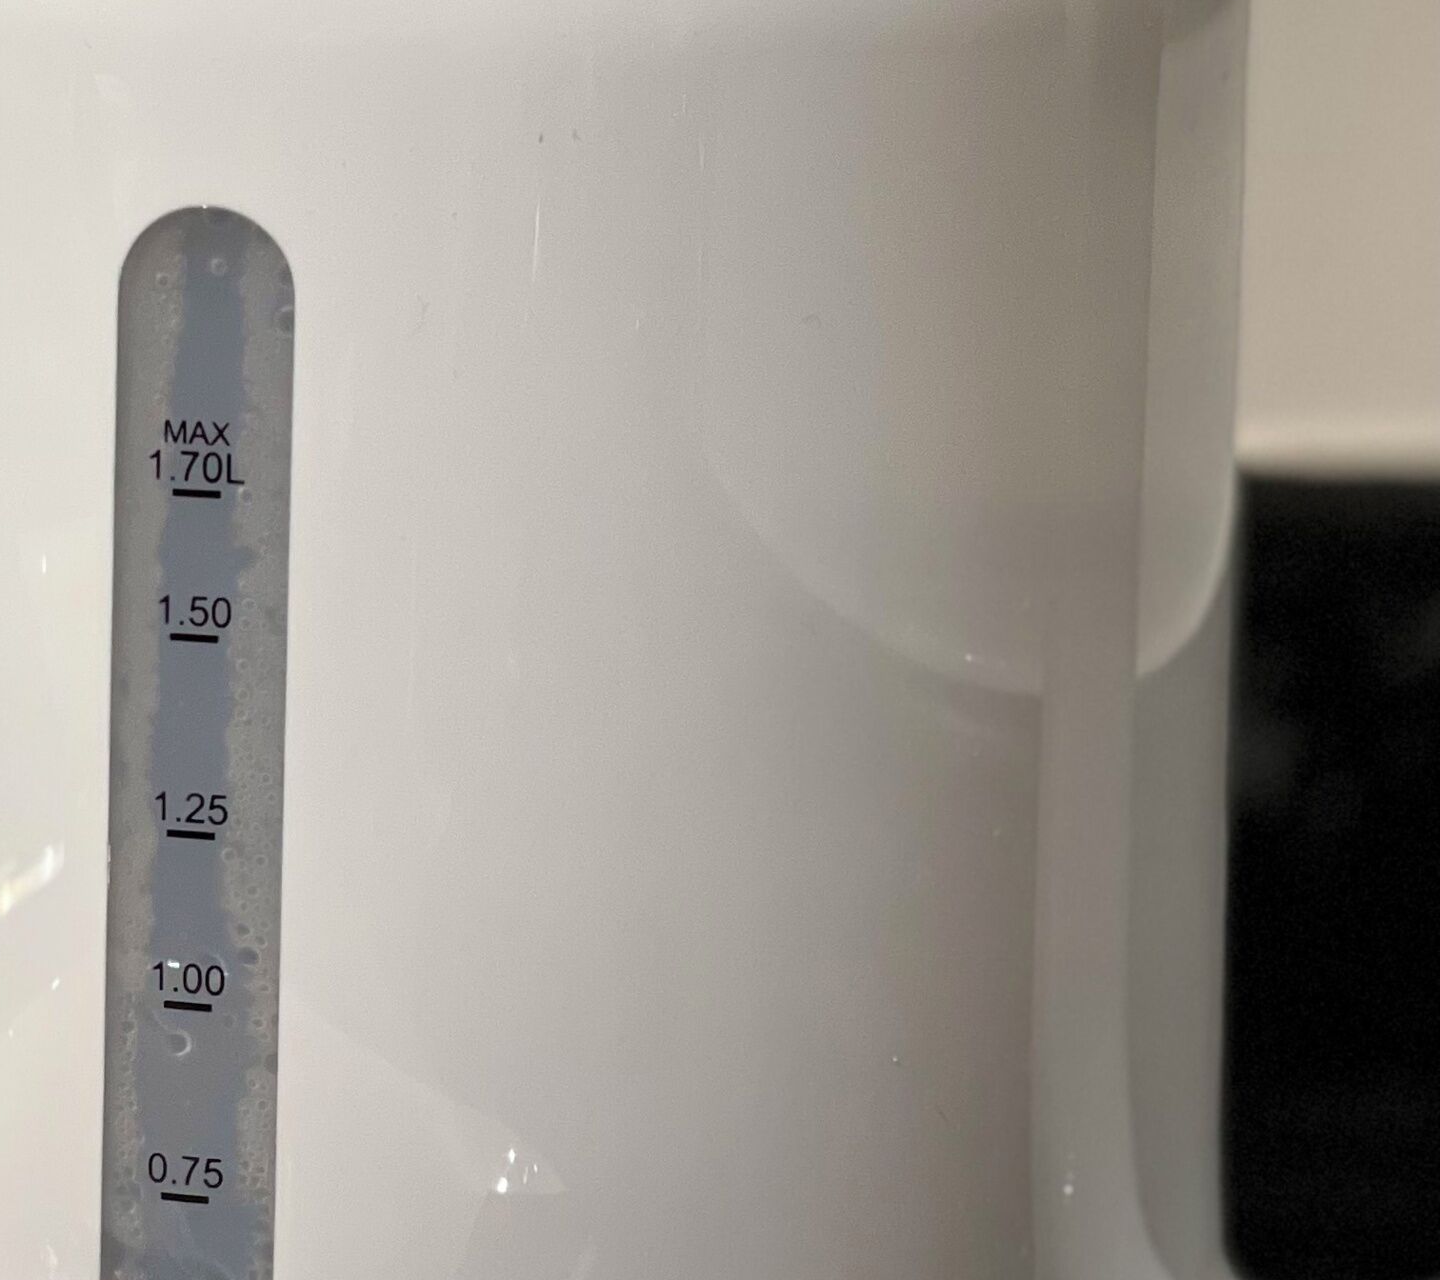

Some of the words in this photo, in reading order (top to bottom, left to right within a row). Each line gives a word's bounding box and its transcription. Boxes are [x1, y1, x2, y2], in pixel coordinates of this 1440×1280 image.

[163, 419, 231, 447] MAX
[149, 449, 246, 486] 1.70L
[158, 595, 233, 629] 1.50
[154, 791, 229, 826] 1.25
[151, 960, 226, 996] 1.00
[147, 1152, 224, 1189] 0.75
